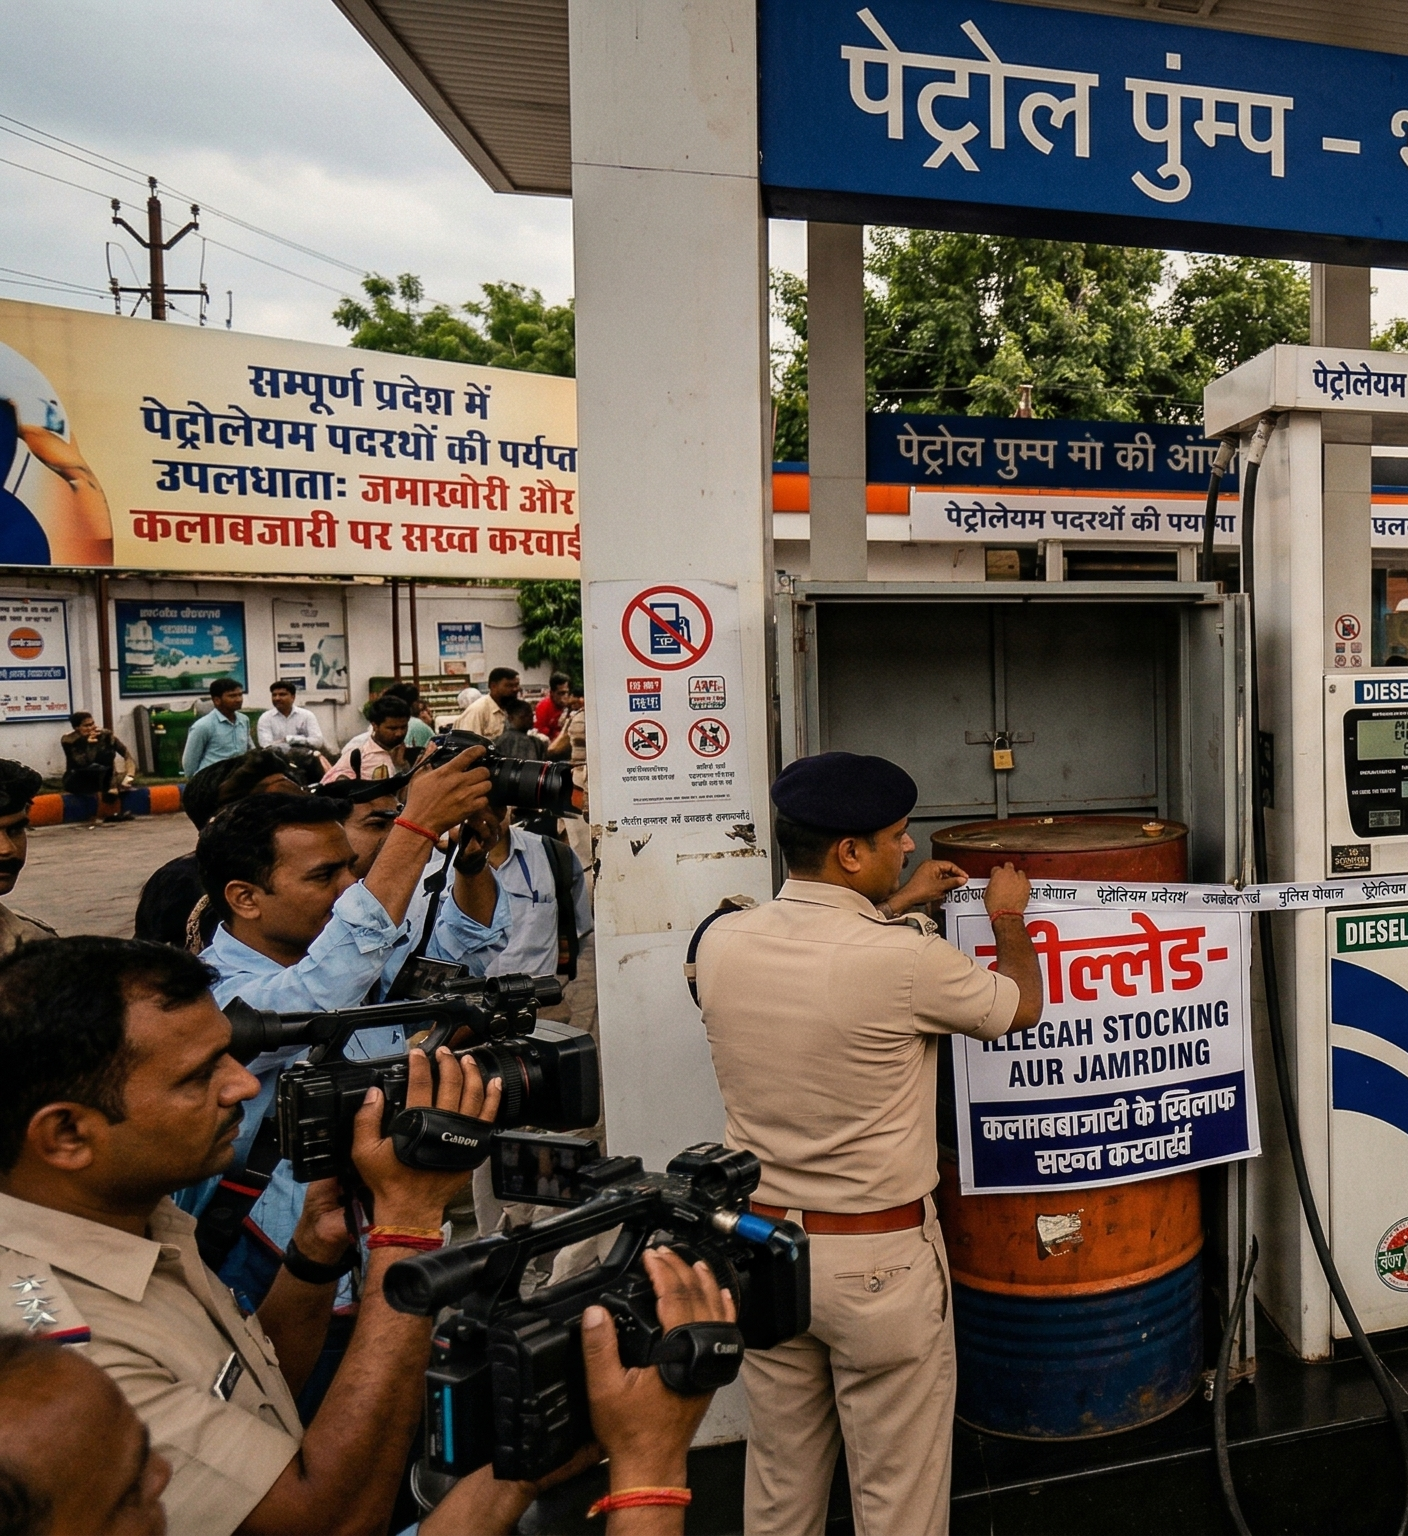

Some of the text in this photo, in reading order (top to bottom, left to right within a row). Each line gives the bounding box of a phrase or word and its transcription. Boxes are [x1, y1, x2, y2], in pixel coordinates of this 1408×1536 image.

[840, 7, 1100, 172] पेट्रोल
[248, 365, 492, 420] सम्पूर्ण प्रदेश में
[445, 429, 491, 466] की
[897, 422, 986, 476] पेट्रोल
[993, 437, 1058, 480] पुम्प
[1114, 432, 1156, 472] की
[519, 479, 576, 515] और
[944, 500, 1047, 533] पेट्रोलेयम
[1131, 506, 1161, 531] की
[129, 509, 340, 548] कलाबजारी
[348, 521, 392, 551] पर
[1103, 1000, 1230, 1044] STOCKING
[1008, 1038, 1211, 1087] AUR JAMRDING
[1132, 1095, 1157, 1126] के
